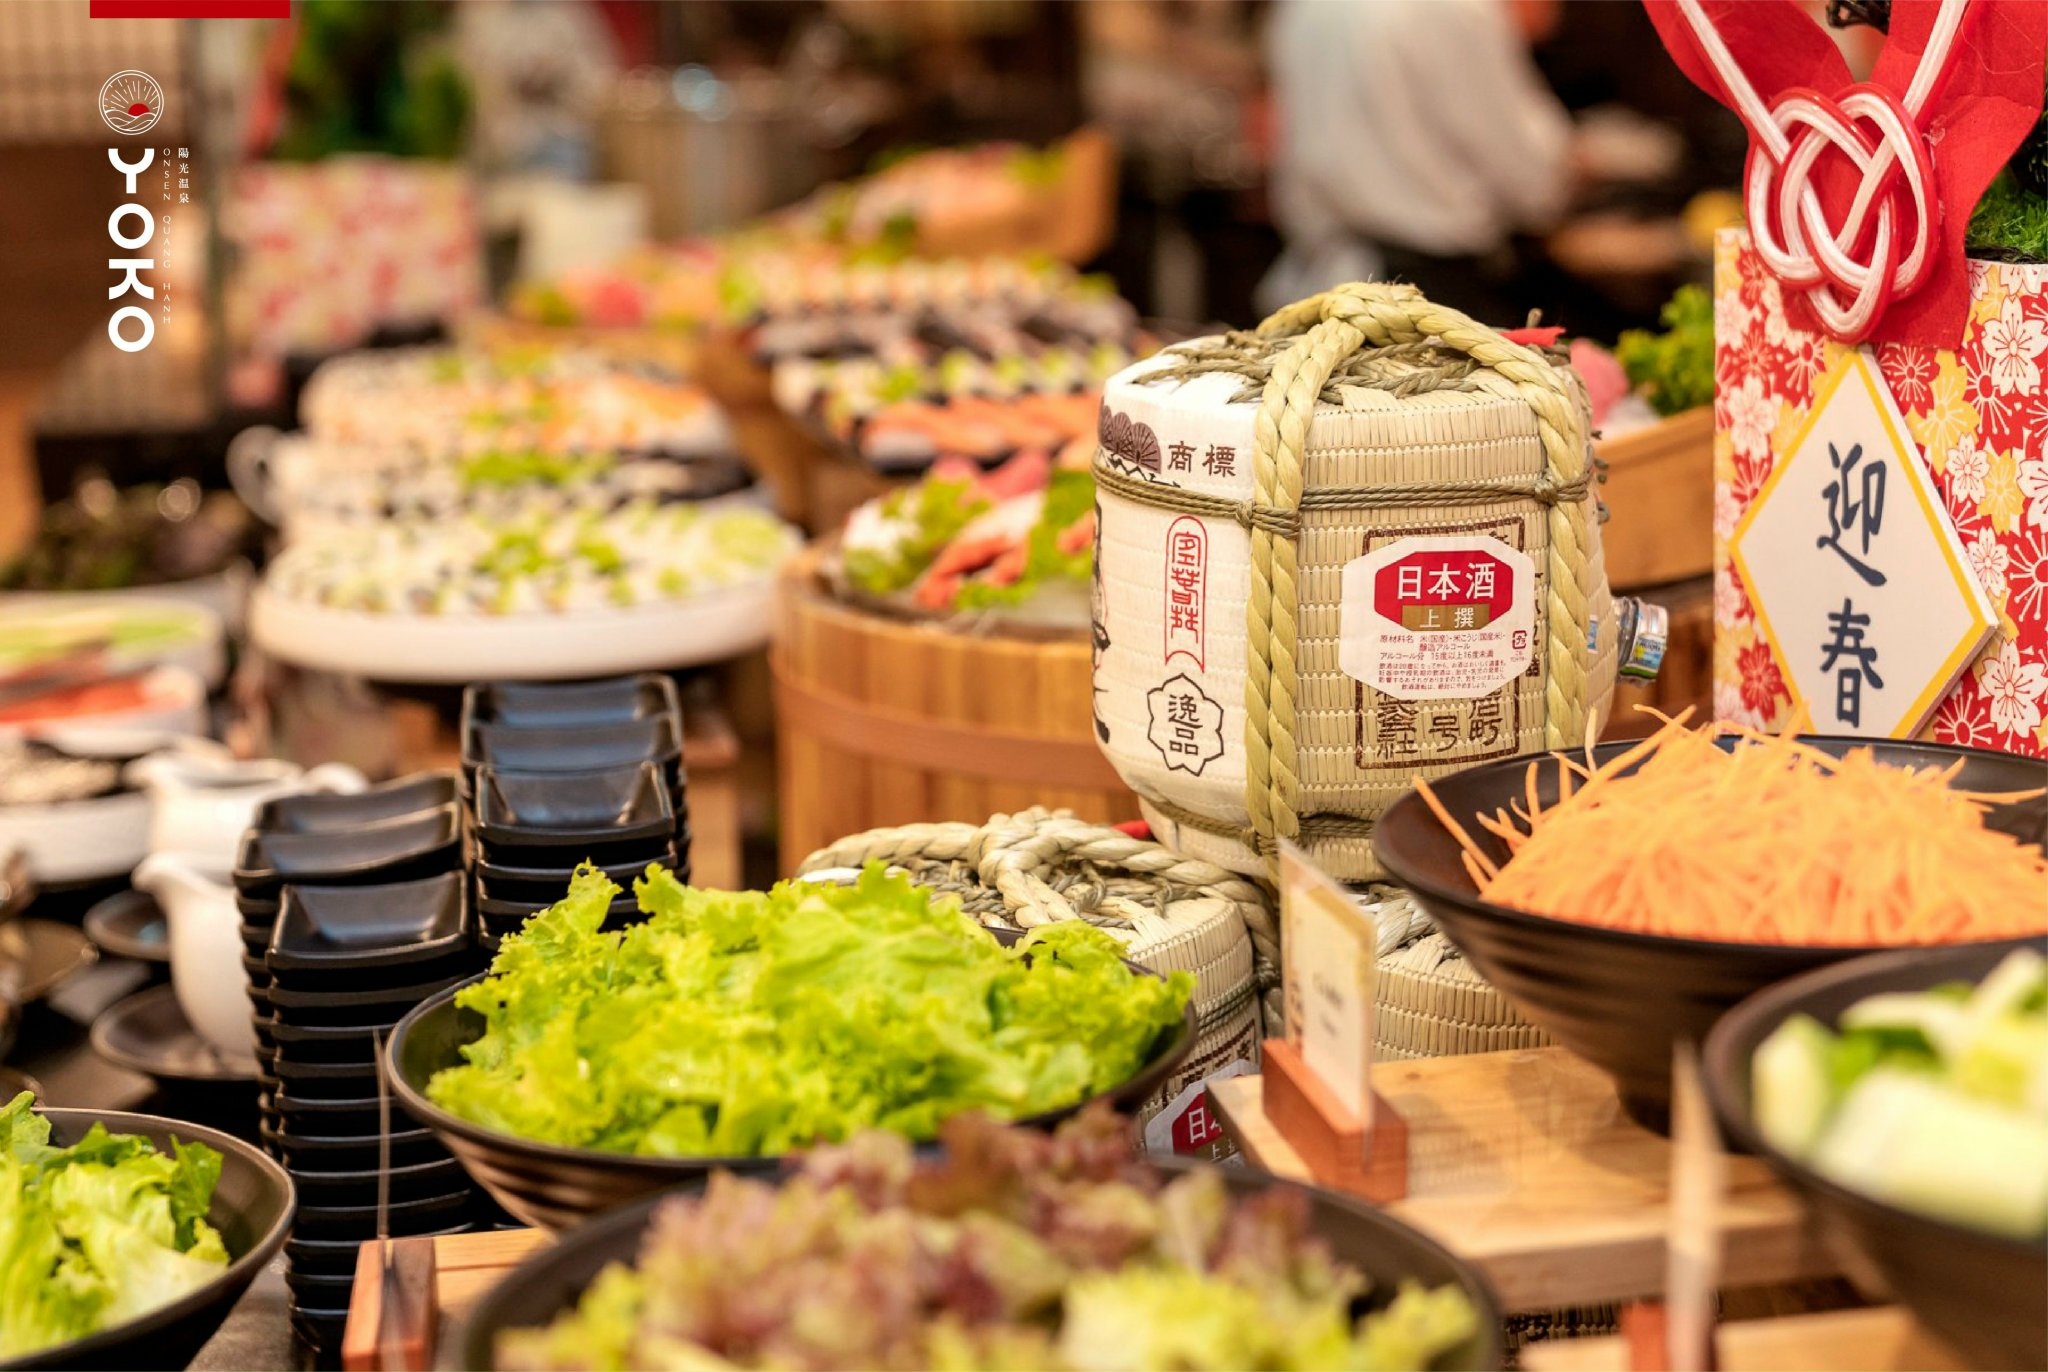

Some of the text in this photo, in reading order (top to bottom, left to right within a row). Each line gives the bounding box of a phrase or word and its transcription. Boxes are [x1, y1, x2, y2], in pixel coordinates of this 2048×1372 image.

[1167, 440, 1238, 479] 商標
[1396, 561, 1497, 601] 日本酒
[1816, 441, 1888, 729] 迎春
[1419, 606, 1475, 629] 上撰
[1380, 634, 1414, 644] 原材料名
[1167, 693, 1204, 757] 逸品
